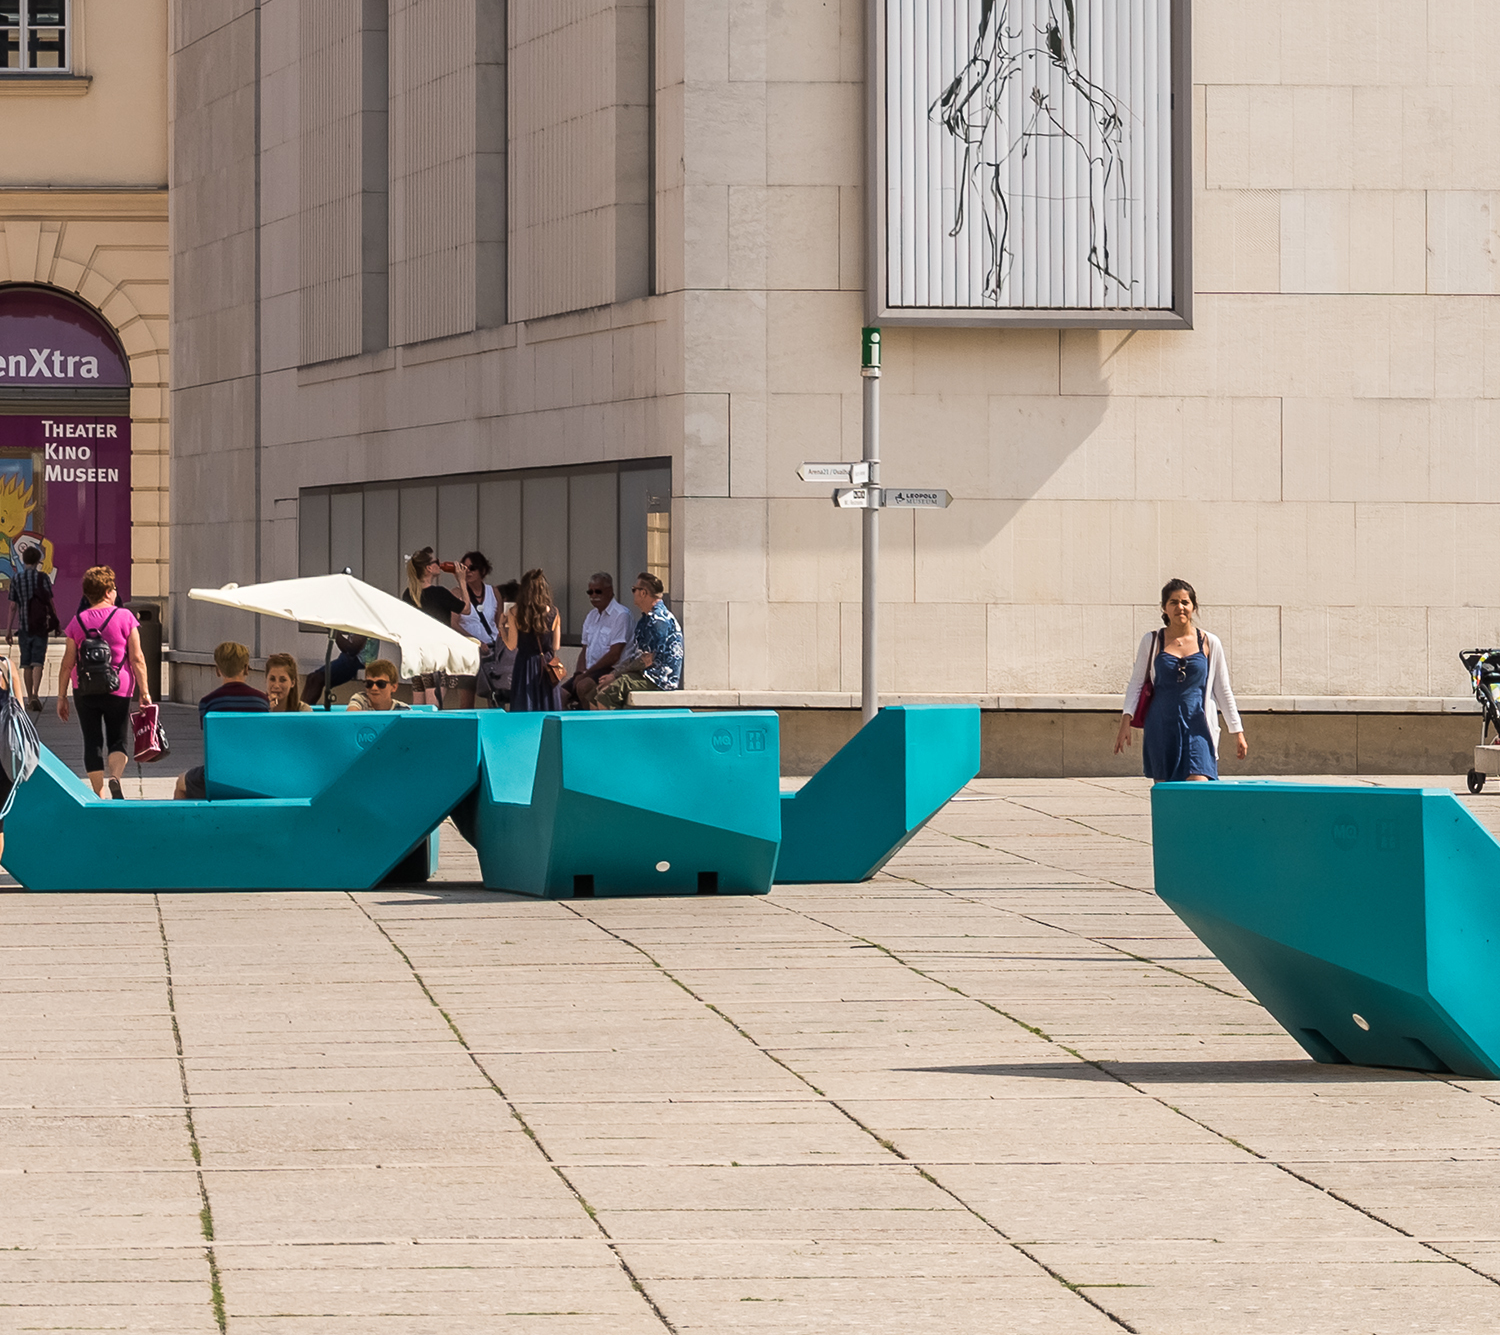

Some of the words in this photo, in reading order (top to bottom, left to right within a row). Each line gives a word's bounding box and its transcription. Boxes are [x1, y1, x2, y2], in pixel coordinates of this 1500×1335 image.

[41, 420, 118, 438] THEATER
[45, 442, 91, 460] KINO
[44, 464, 118, 482] MUSEEN
